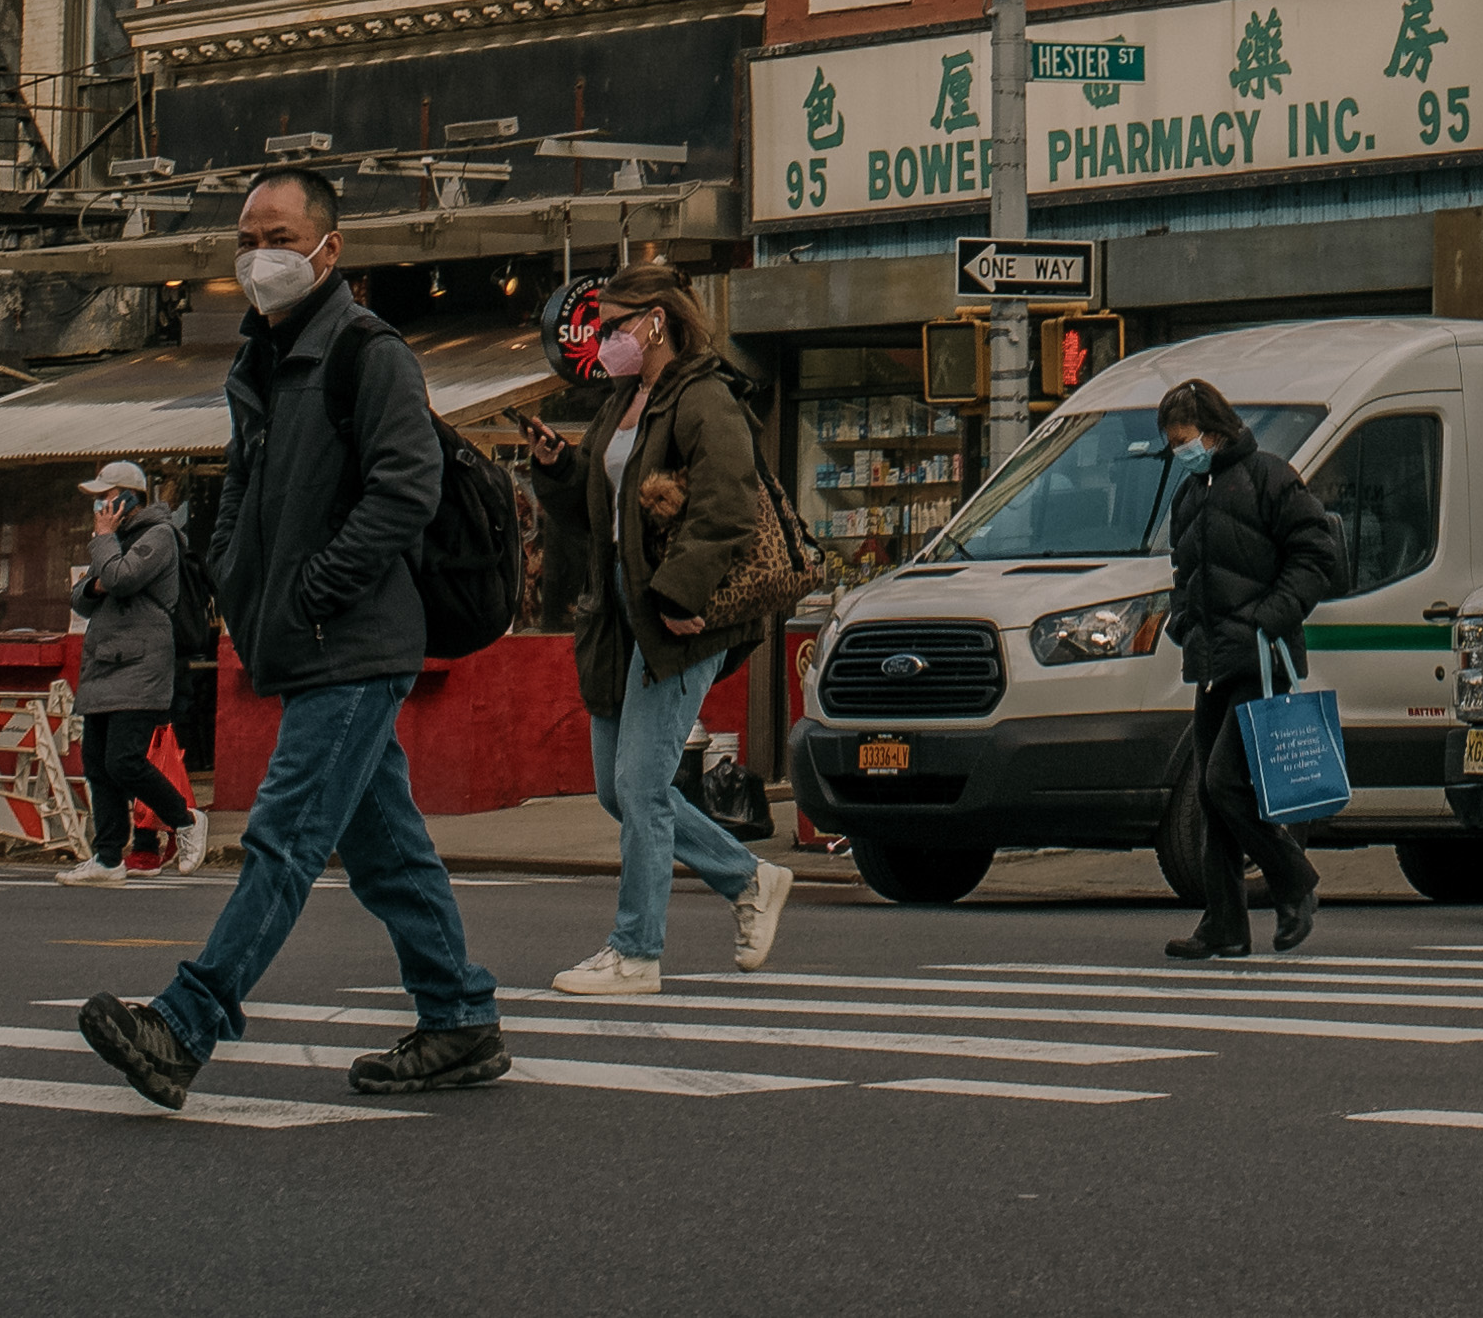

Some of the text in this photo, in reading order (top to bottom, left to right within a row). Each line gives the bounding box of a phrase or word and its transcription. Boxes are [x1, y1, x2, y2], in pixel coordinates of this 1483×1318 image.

[1037, 44, 1136, 78] HESTER ST
[786, 85, 1471, 210] 95 BOWER PHARMACY INC. 95
[978, 257, 1076, 281] ONE WAY
[1407, 707, 1447, 717] BATTERY
